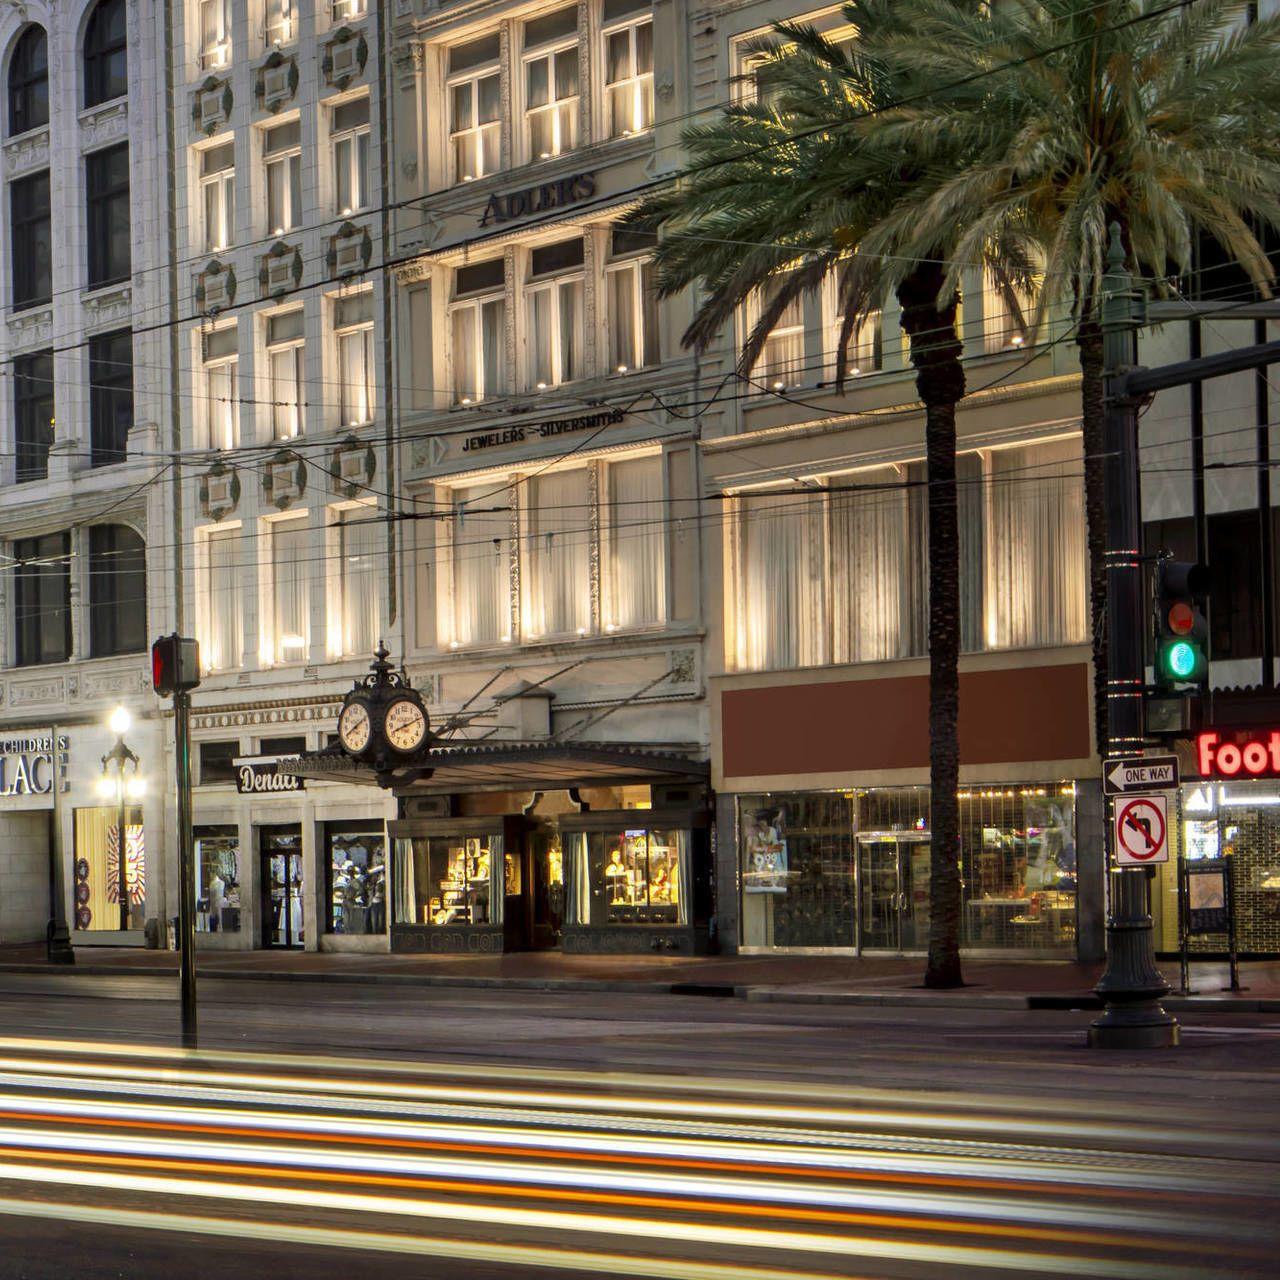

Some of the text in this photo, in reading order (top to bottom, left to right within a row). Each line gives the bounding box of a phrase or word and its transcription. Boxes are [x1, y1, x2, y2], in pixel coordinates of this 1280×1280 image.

[462, 428, 525, 451] JEWELERS
[3, 735, 69, 754] CHILDRES
[1198, 732, 1280, 777] Foot
[1125, 767, 1171, 783] ONE WAY
